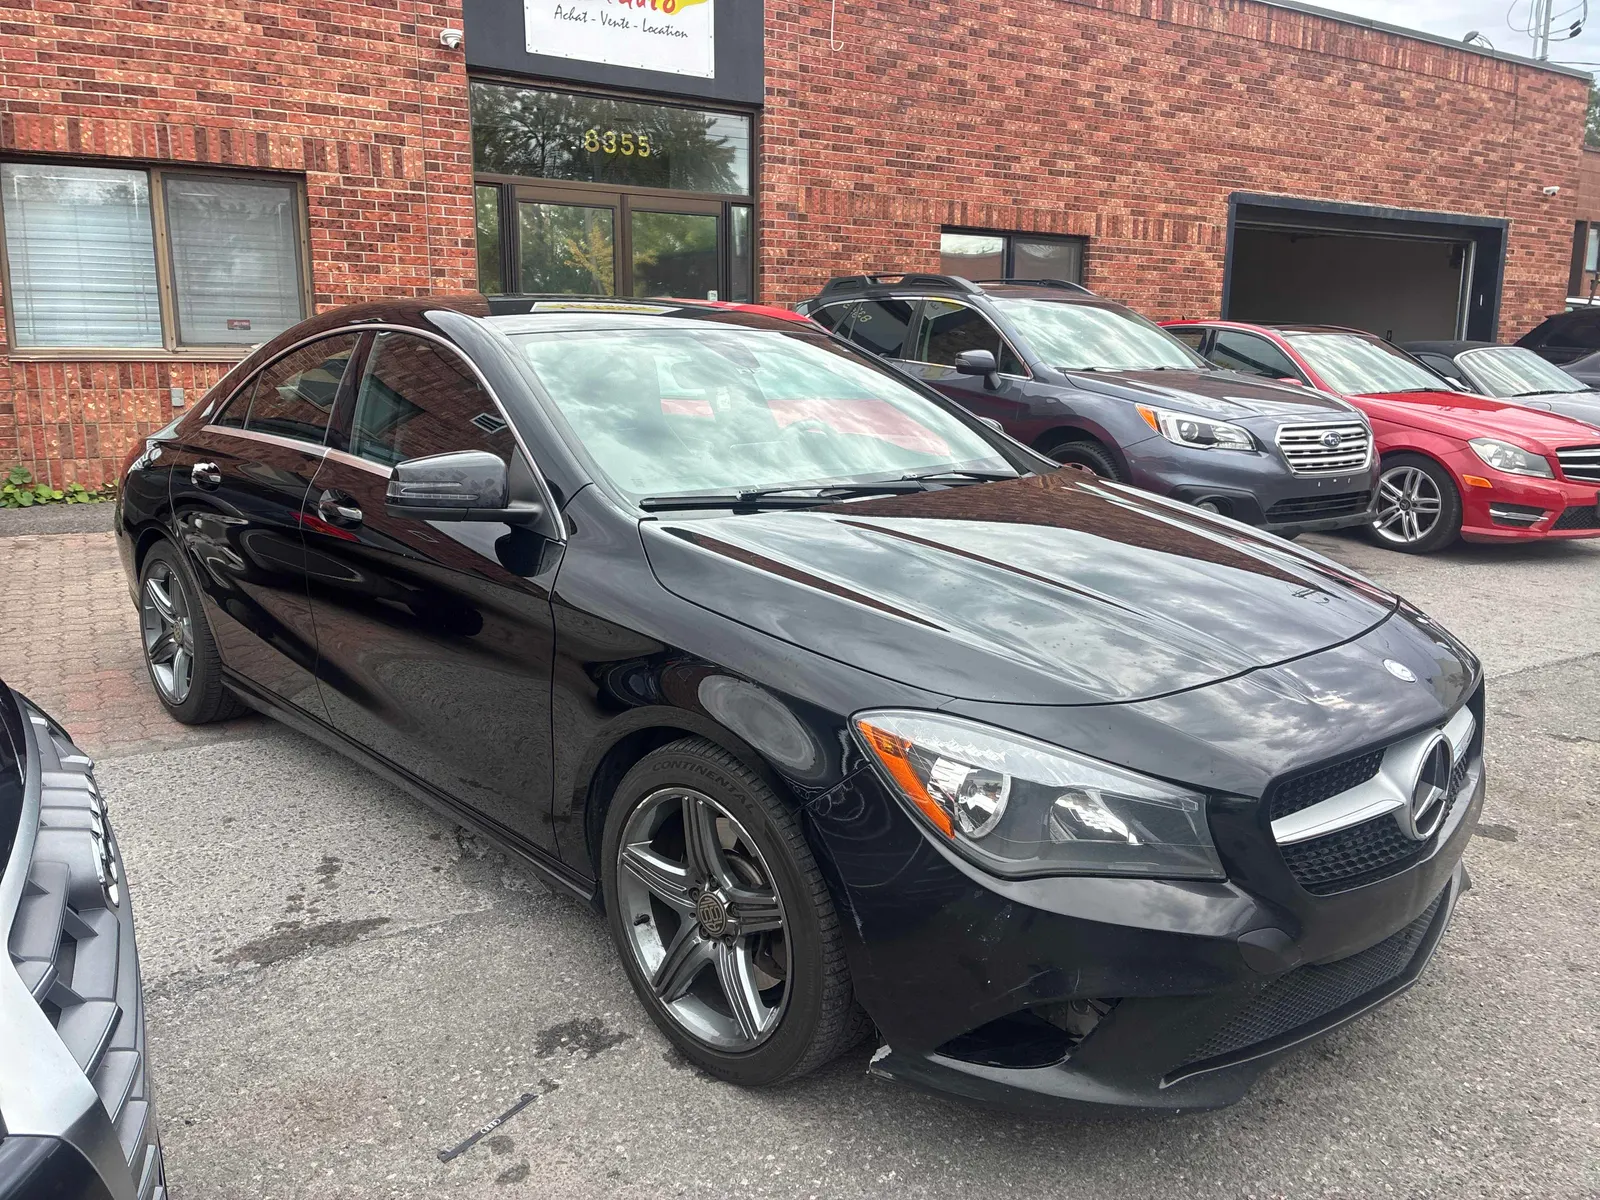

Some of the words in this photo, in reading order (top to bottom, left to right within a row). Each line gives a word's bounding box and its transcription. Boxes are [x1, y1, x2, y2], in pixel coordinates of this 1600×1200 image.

[554, 4, 588, 23] Achat
[600, 11, 630, 30] Vente
[642, 18, 689, 38] Location
[584, 129, 651, 158] 8355
[652, 760, 755, 815] CONTINENTAL
